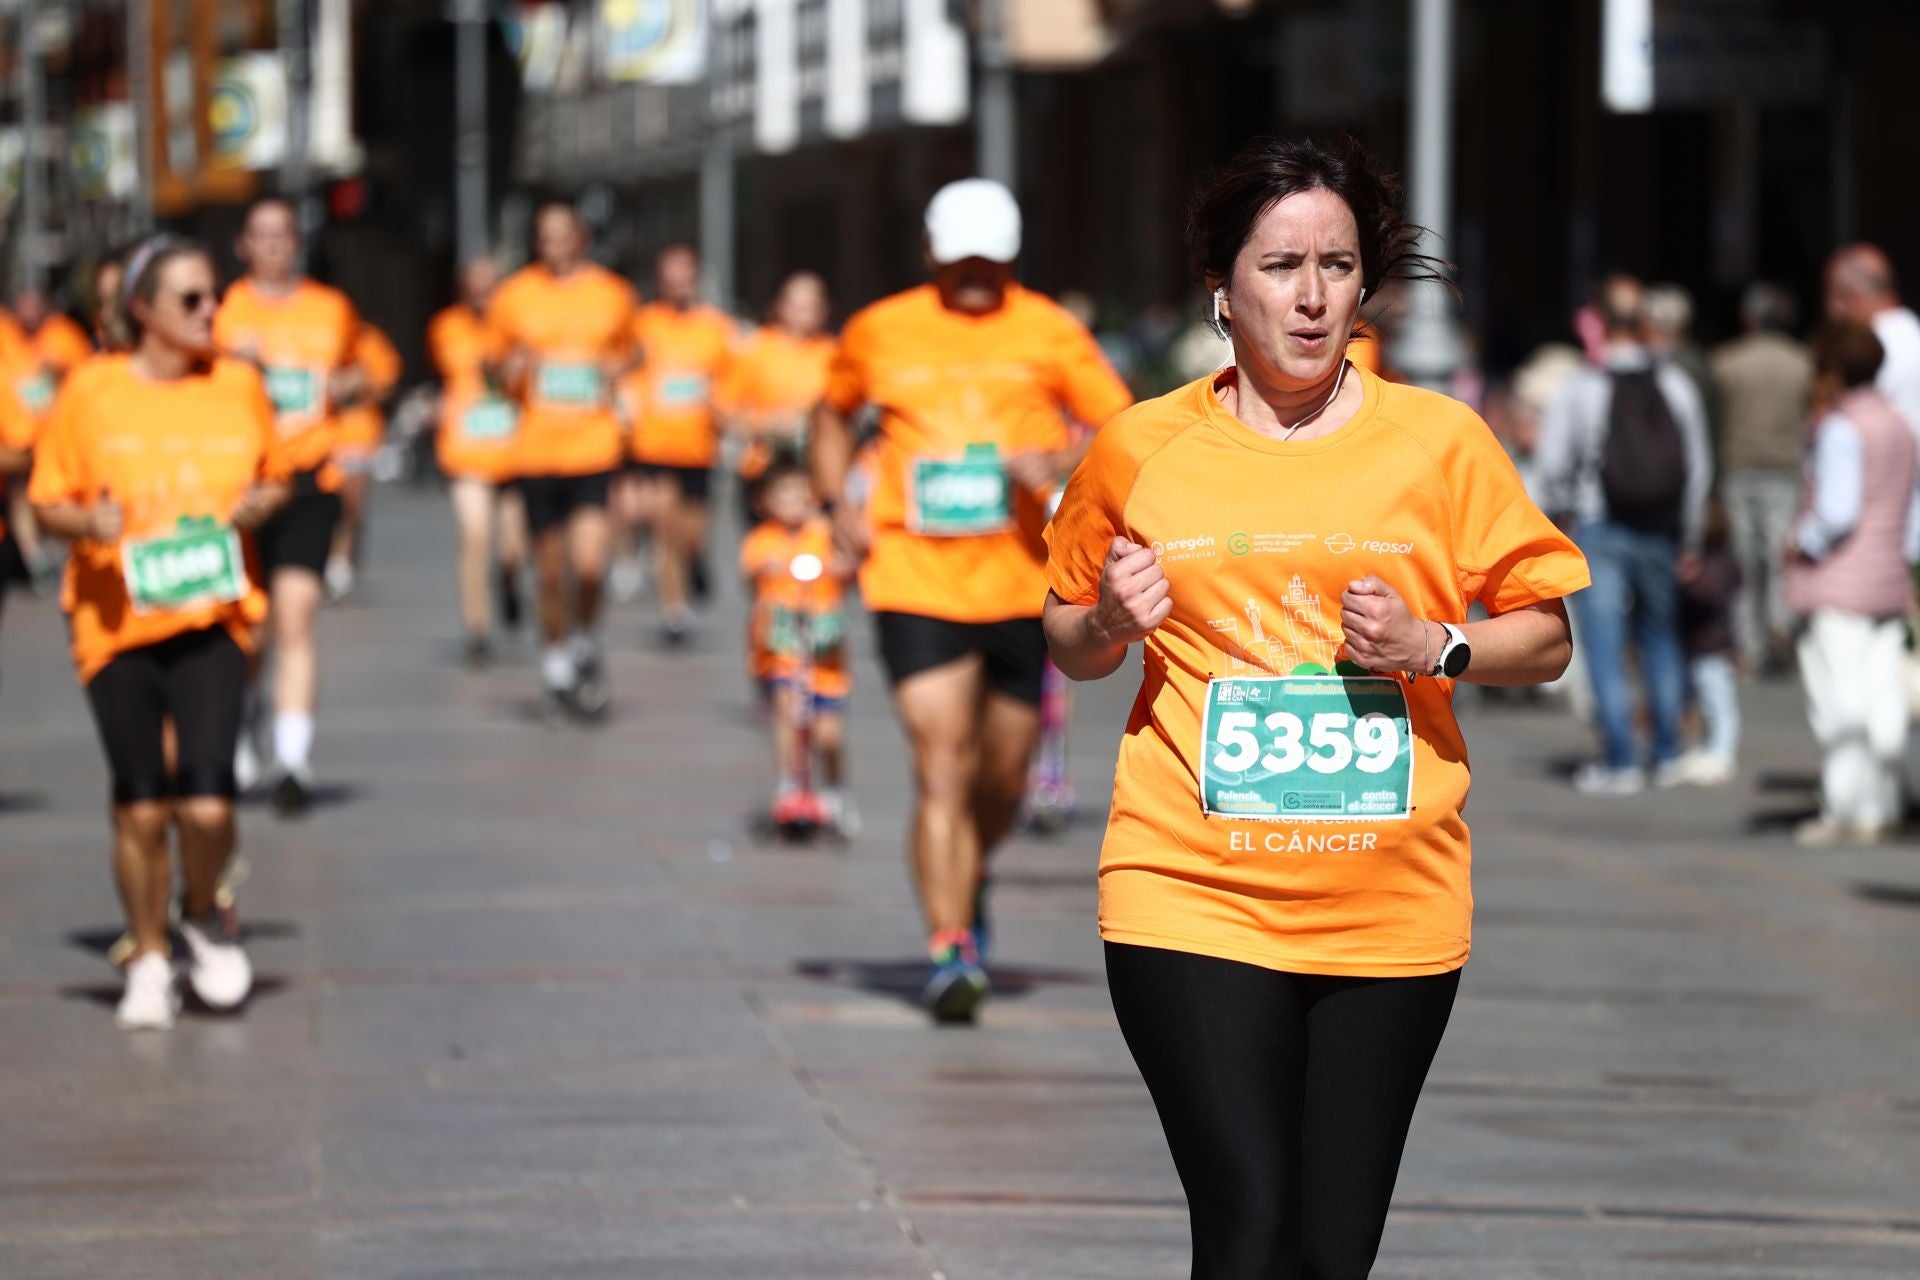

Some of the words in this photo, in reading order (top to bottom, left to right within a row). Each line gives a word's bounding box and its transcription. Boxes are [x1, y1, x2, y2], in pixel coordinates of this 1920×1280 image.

[1166, 535, 1215, 550] oregón
[1362, 540, 1414, 554] repsol
[1167, 551, 1216, 562] comercial
[1213, 712, 1399, 774] 5359
[1217, 790, 1259, 800] Palencia
[1363, 791, 1396, 800] contra
[1349, 800, 1360, 809] el
[1361, 800, 1396, 809] cáncer
[1230, 831, 1256, 851] EL
[1264, 829, 1377, 853] CÁNCER
